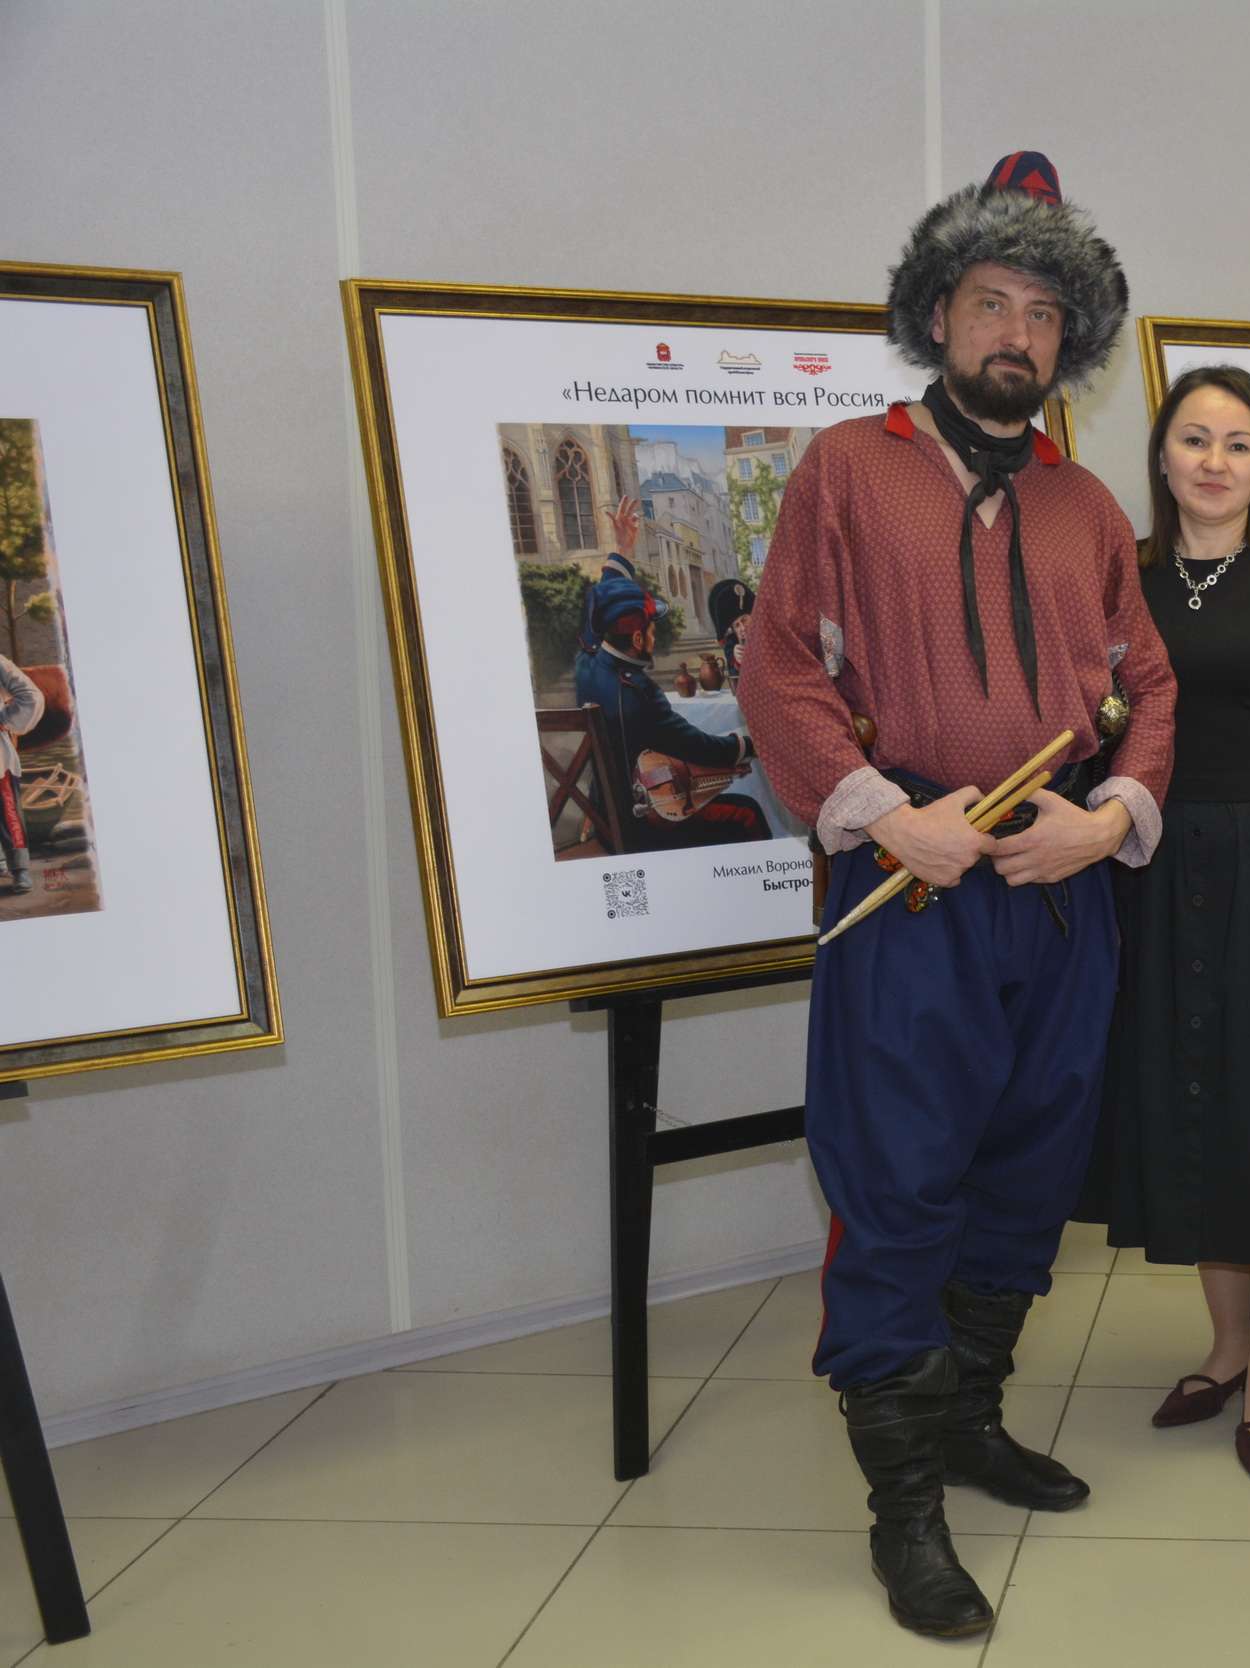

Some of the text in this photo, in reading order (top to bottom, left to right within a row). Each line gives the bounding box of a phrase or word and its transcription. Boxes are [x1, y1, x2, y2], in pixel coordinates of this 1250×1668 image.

[562, 381, 678, 409] «Недаром
[685, 388, 765, 405] помнит
[773, 390, 806, 406] вся
[713, 864, 763, 879] Михаил
